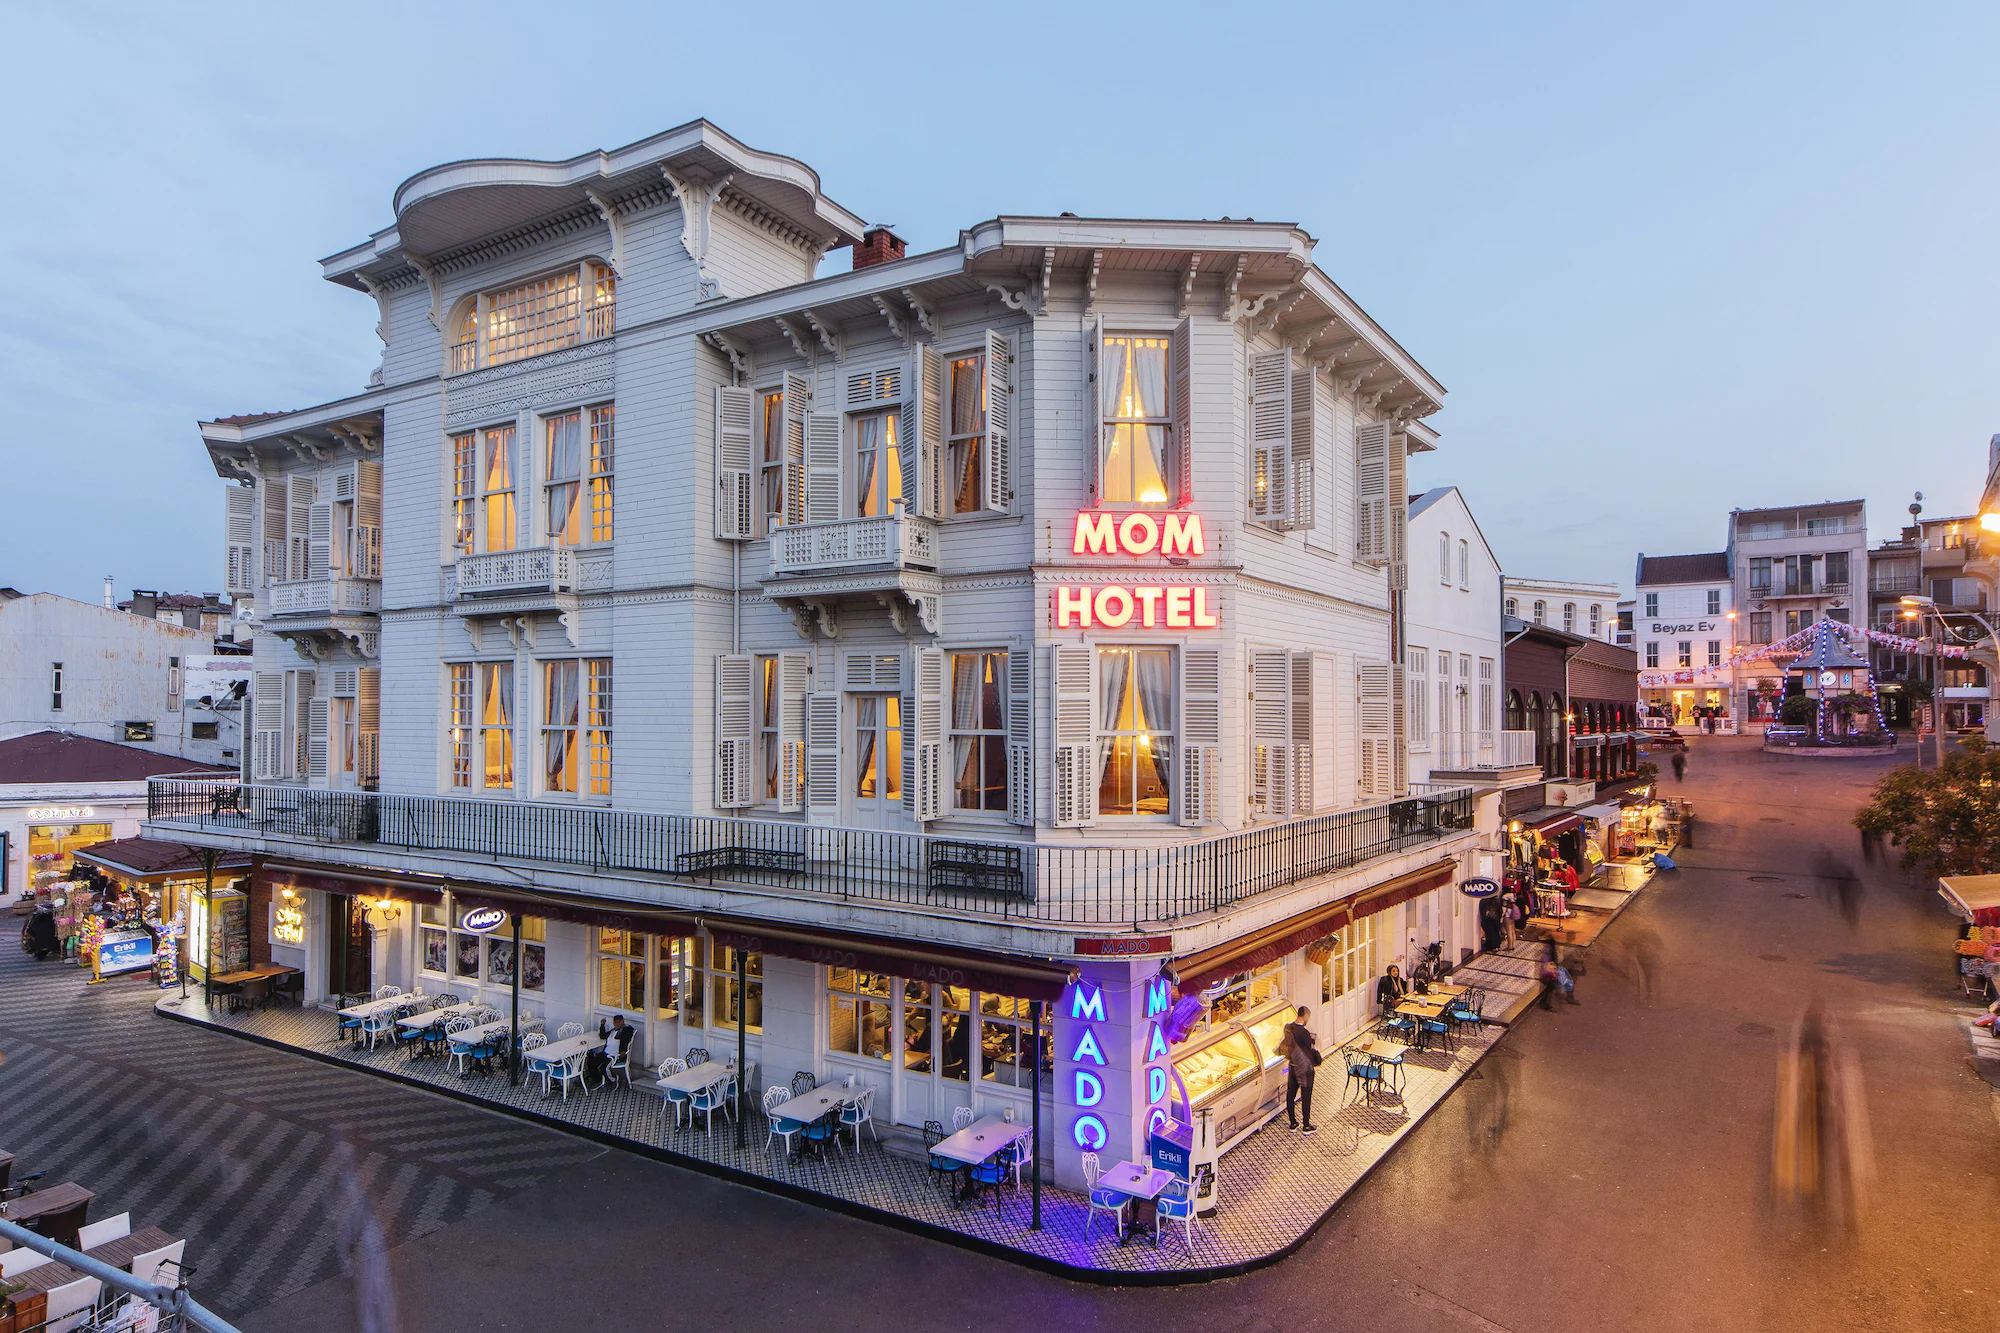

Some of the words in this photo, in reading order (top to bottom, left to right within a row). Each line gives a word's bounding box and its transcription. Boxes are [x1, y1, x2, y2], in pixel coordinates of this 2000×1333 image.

[1073, 512, 1205, 555] MOM
[1058, 585, 1217, 628] HOTEL
[1652, 623, 1694, 635] Beyaz
[1698, 621, 1716, 632] Ev
[1465, 883, 1494, 893] MADO
[470, 910, 502, 927] MADO
[113, 942, 136, 953] Erikli
[1101, 940, 1150, 954] MADO
[1250, 945, 1275, 963] MADO
[812, 947, 857, 968] MADO
[912, 964, 963, 986] MADO
[1070, 983, 1108, 1151] MADO
[1158, 1149, 1182, 1164] Erikli
